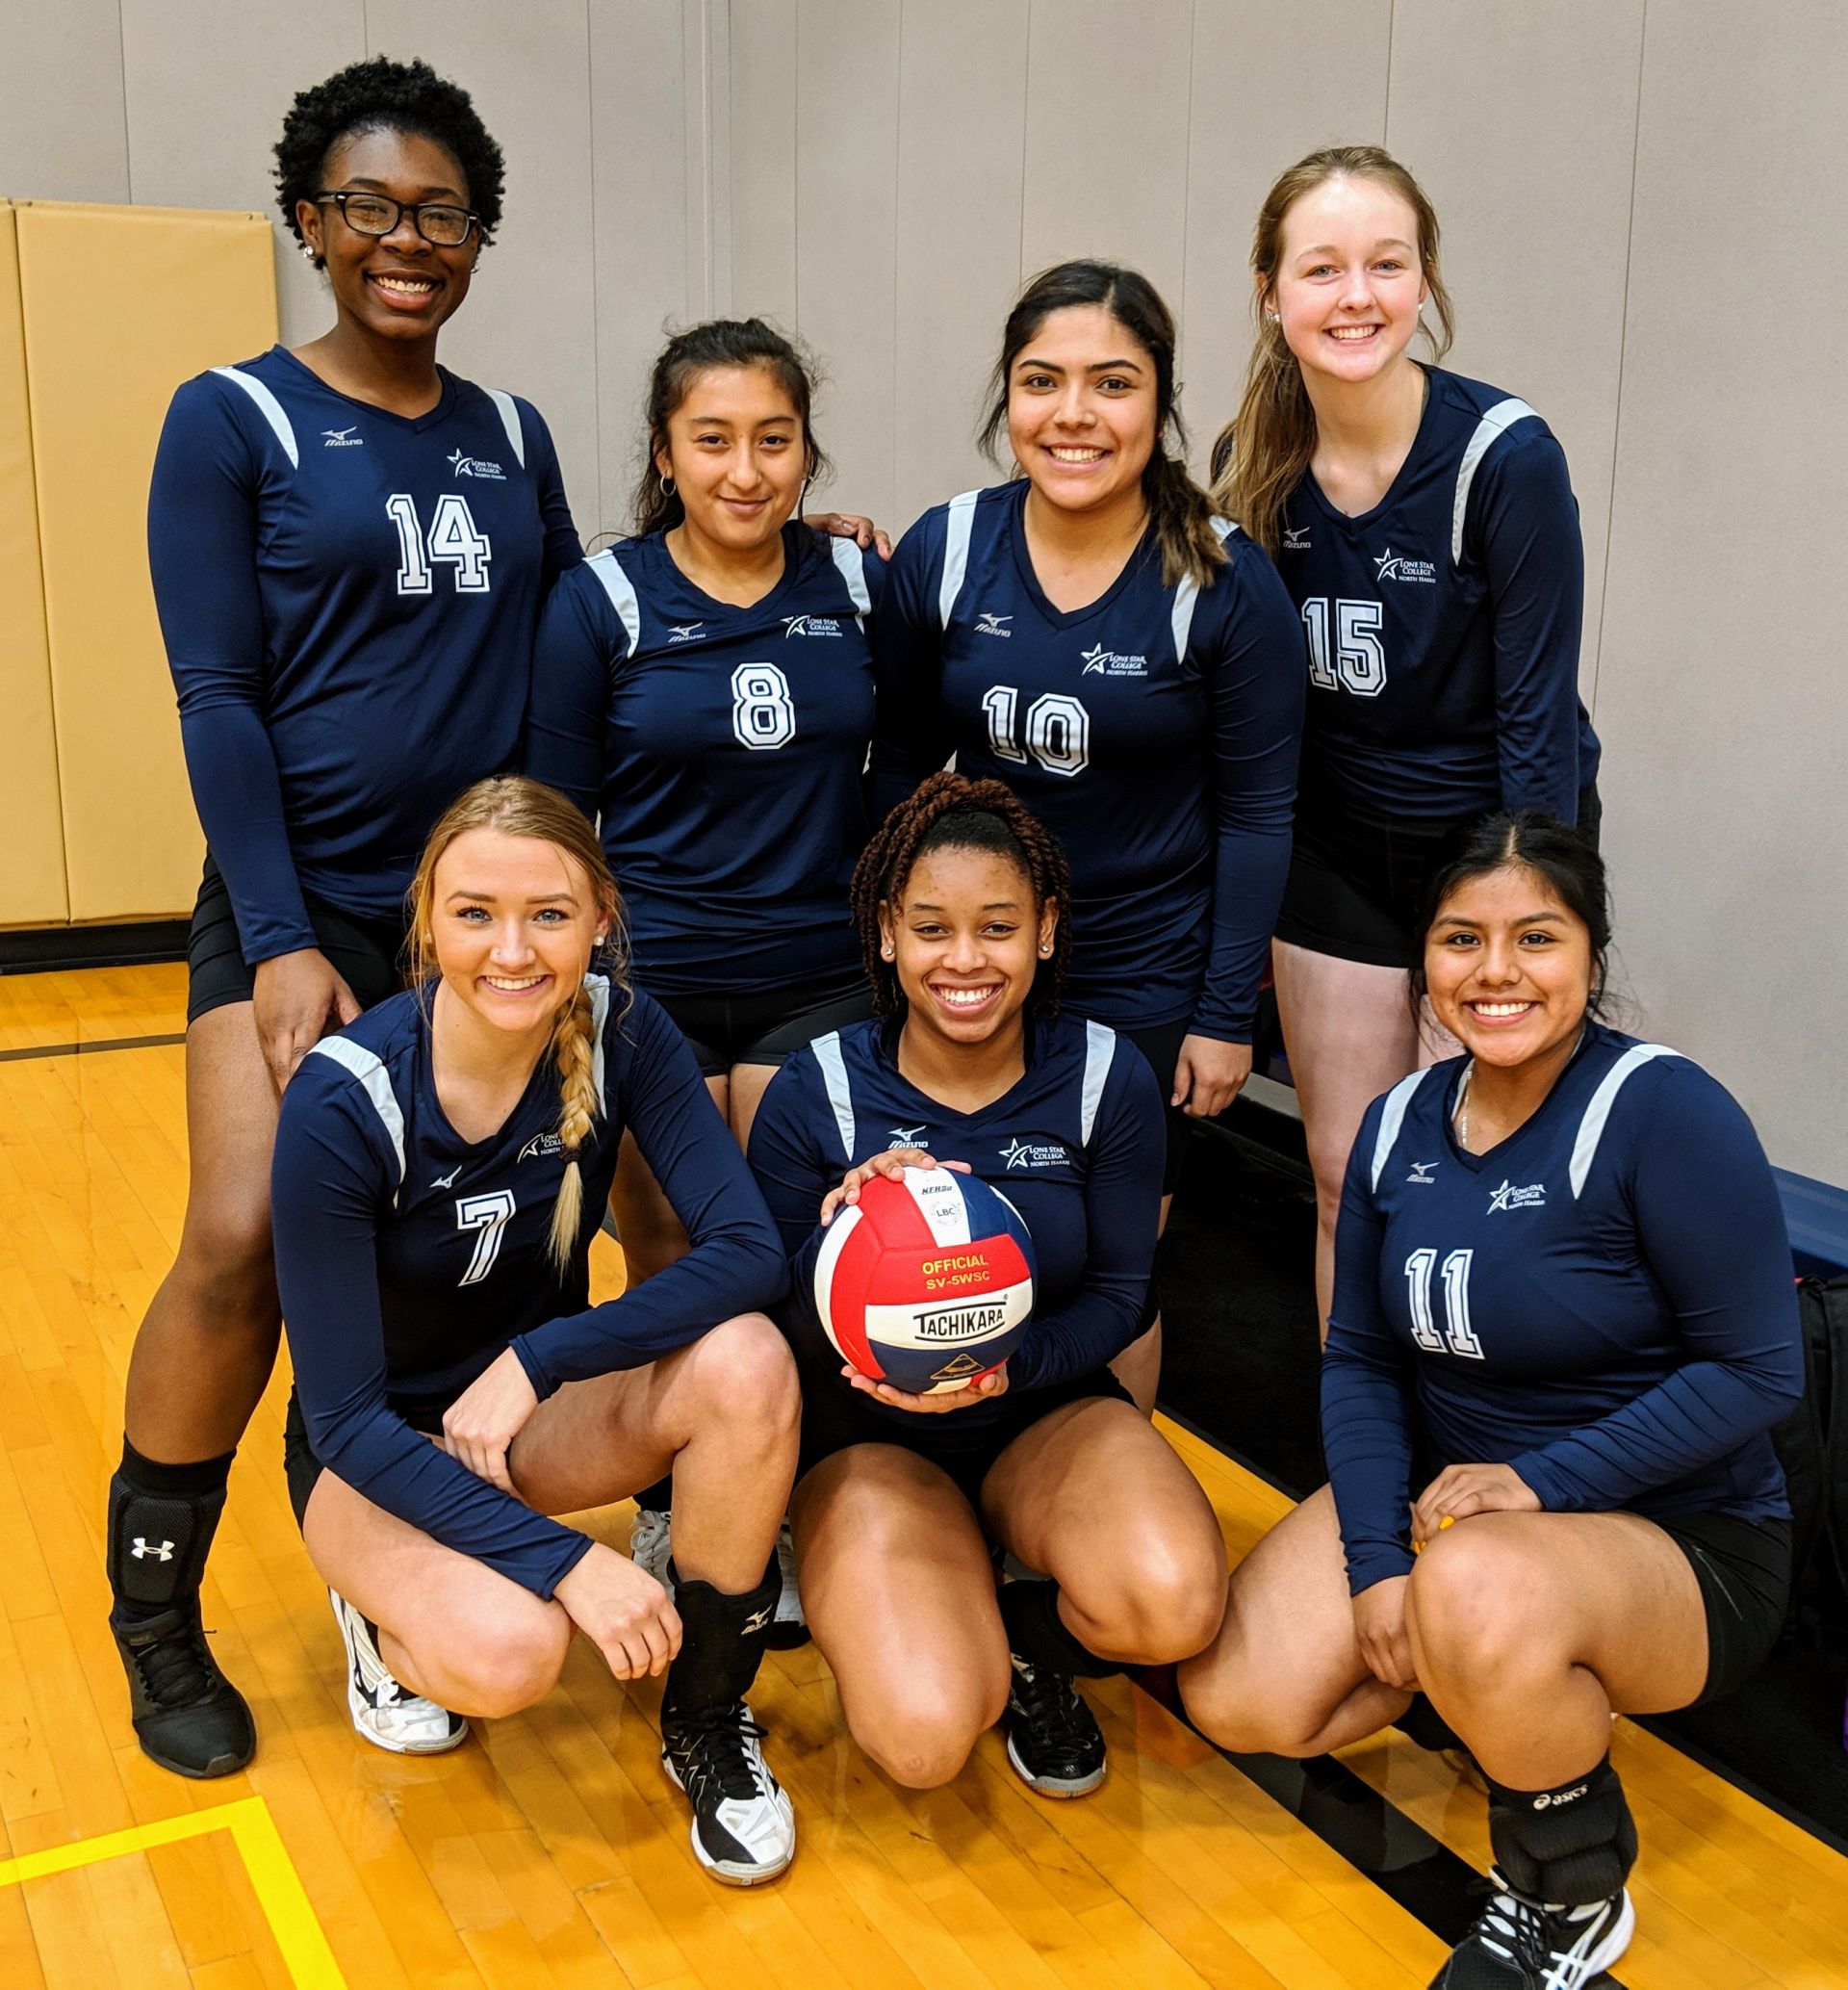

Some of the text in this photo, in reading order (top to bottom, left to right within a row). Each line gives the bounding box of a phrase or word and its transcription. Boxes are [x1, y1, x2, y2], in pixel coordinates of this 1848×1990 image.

[385, 493, 492, 595] 14
[1401, 567, 1432, 577] COLLEGE
[1301, 597, 1387, 697] 15
[731, 662, 796, 750] 8
[982, 685, 1090, 777] 10
[455, 1189, 517, 1287] 7
[936, 1207, 956, 1217] LBC
[922, 1254, 989, 1275] OFFICIAL
[926, 1271, 990, 1290] SV-5WSC
[1404, 1248, 1486, 1360] 11
[913, 1307, 1004, 1337] TACHIKARA
